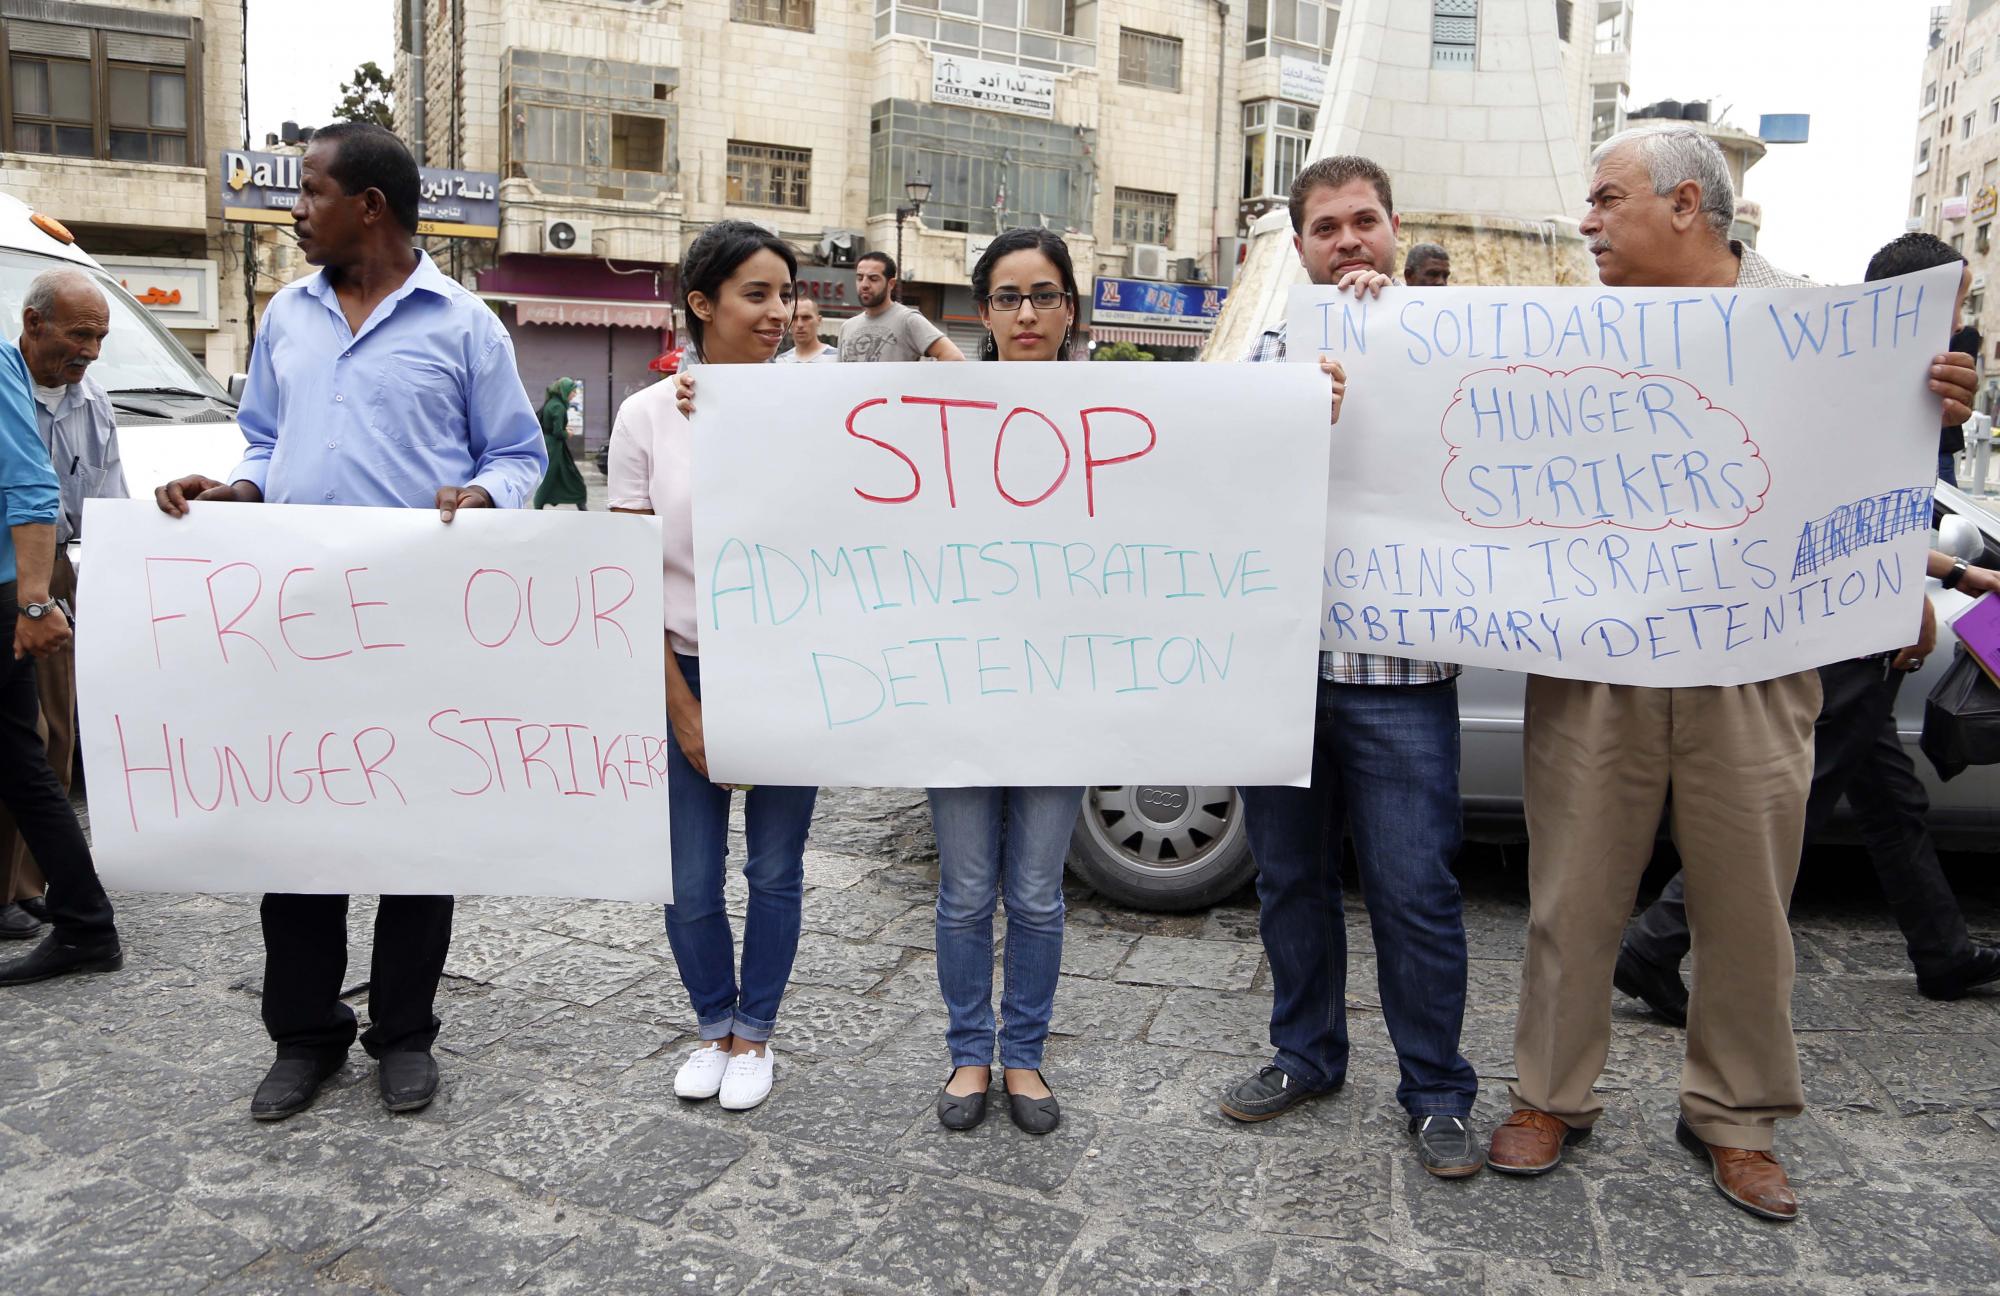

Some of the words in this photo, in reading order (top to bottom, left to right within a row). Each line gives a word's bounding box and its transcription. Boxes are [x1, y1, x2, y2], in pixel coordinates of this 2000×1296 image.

[934, 84, 974, 98] MILDA
[980, 91, 1014, 104] ADAM
[227, 152, 302, 190] Dall
[456, 176, 495, 200] دلة
[1101, 281, 1121, 302] XL
[1315, 301, 1367, 354] IN
[1399, 294, 1738, 386] SOLIDARITY
[1768, 284, 1925, 362] WITH
[1470, 383, 1694, 441] HUNGER
[845, 394, 1157, 519] STOP
[1468, 451, 1747, 520] STRIKERS
[710, 537, 1279, 631] ADMINISTRATIVE
[1319, 601, 1563, 662] RBITRARY
[1580, 551, 1903, 660] DETENTION
[1528, 533, 1777, 605] ISRAEL'S
[145, 557, 406, 671] FREE
[464, 566, 635, 659] OUR
[810, 632, 1236, 730] DETENTION
[114, 713, 407, 833] HUNGER
[428, 708, 667, 802] STRIKERS
